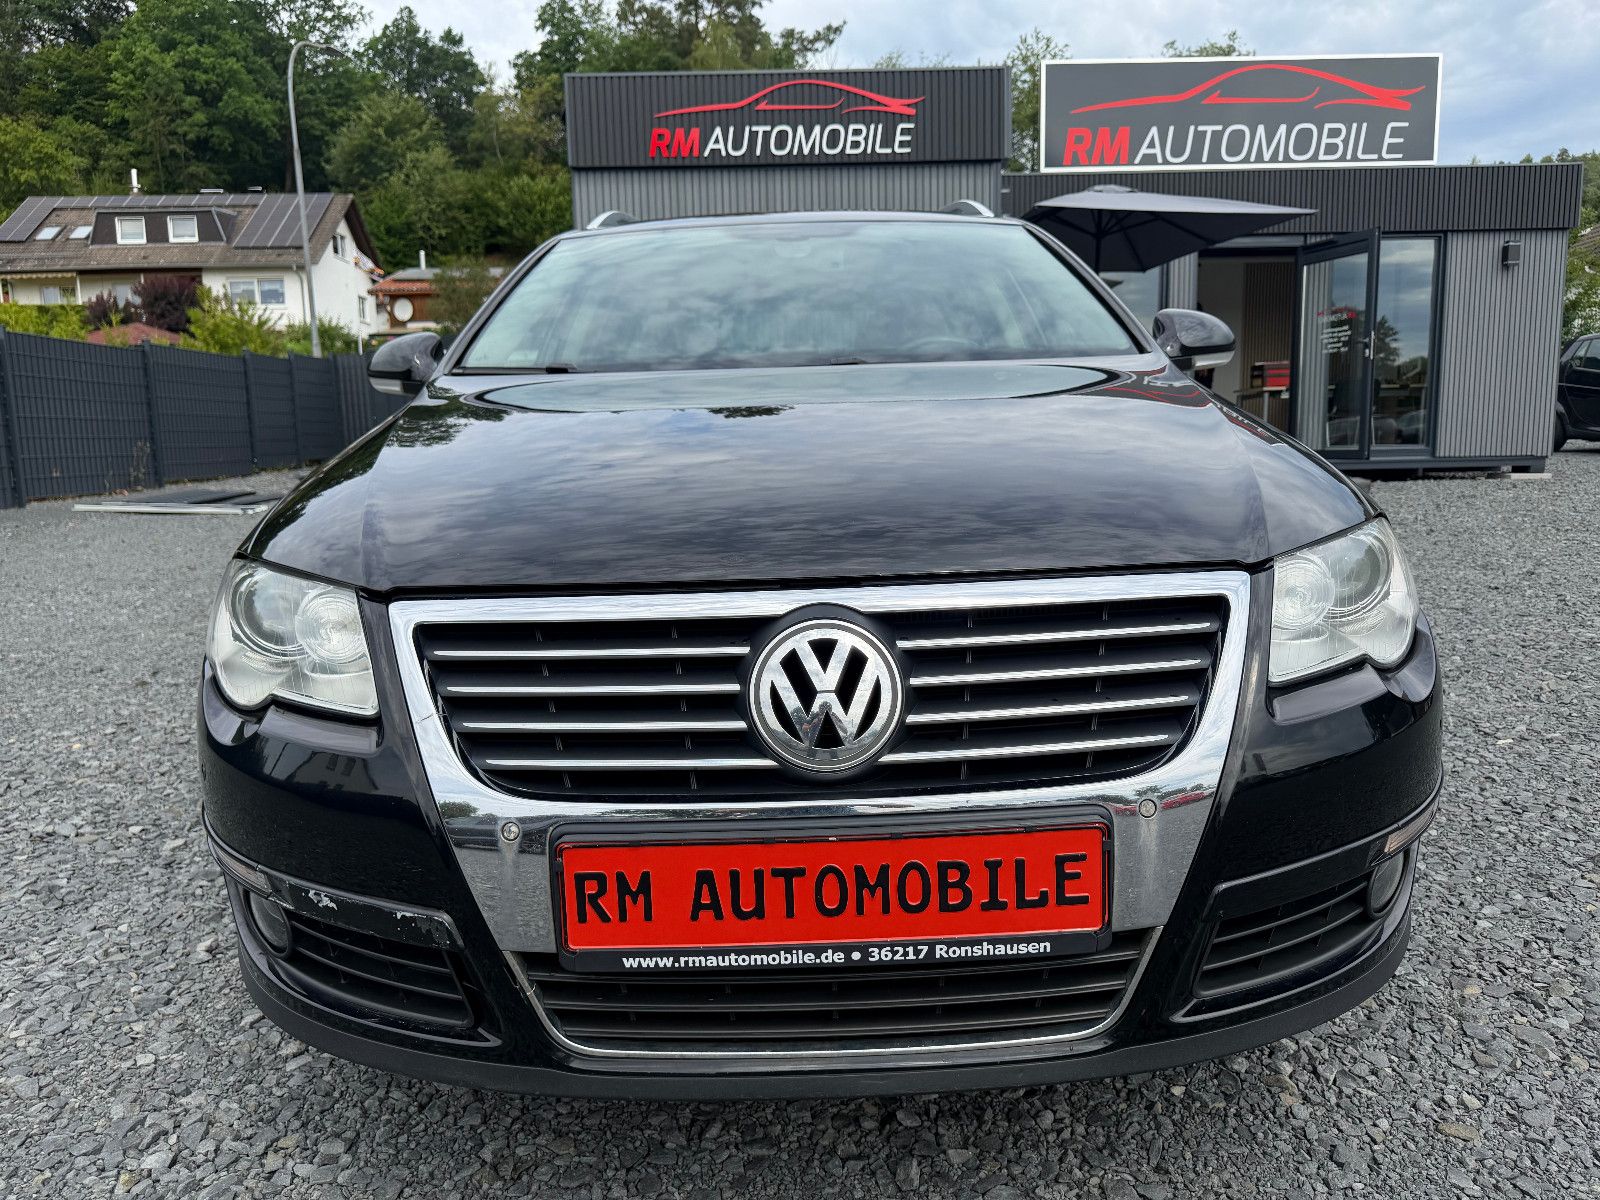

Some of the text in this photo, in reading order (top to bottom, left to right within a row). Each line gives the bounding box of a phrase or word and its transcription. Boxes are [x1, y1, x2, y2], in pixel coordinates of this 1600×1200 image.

[648, 122, 916, 159] RM AUTOMOBILE
[1062, 121, 1410, 166] RM AUTOMOBILE
[573, 852, 1090, 924] RM AUTOMOBILE
[622, 940, 1051, 970] www.rmautomobile.de 36217 Ronshausen
